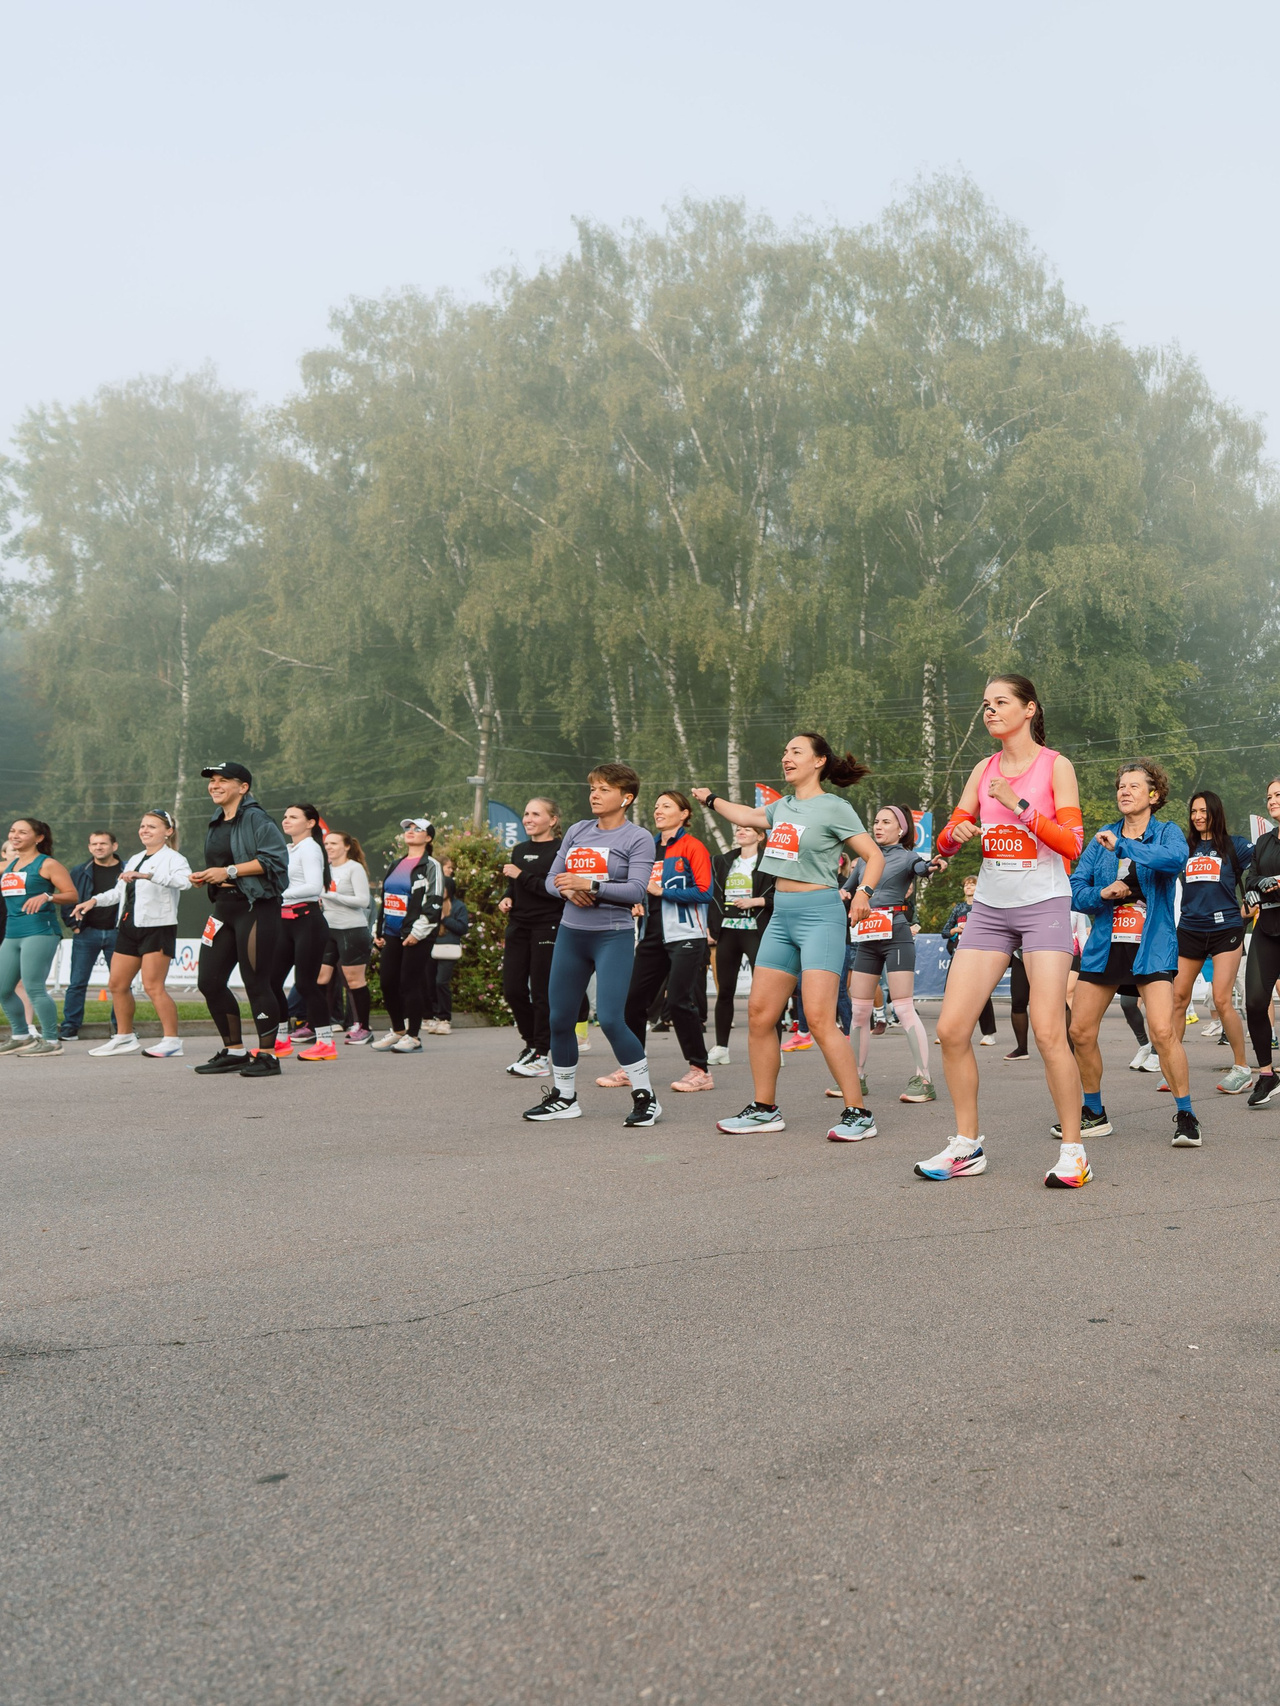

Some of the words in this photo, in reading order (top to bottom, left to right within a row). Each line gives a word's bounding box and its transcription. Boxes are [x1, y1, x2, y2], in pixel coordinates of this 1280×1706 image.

[773, 832, 792, 845] 2105
[990, 838, 1023, 852] 2008
[573, 857, 596, 868] 2015
[1193, 863, 1212, 871] 2210
[864, 919, 883, 930] 2077
[1112, 916, 1137, 928] 2189
